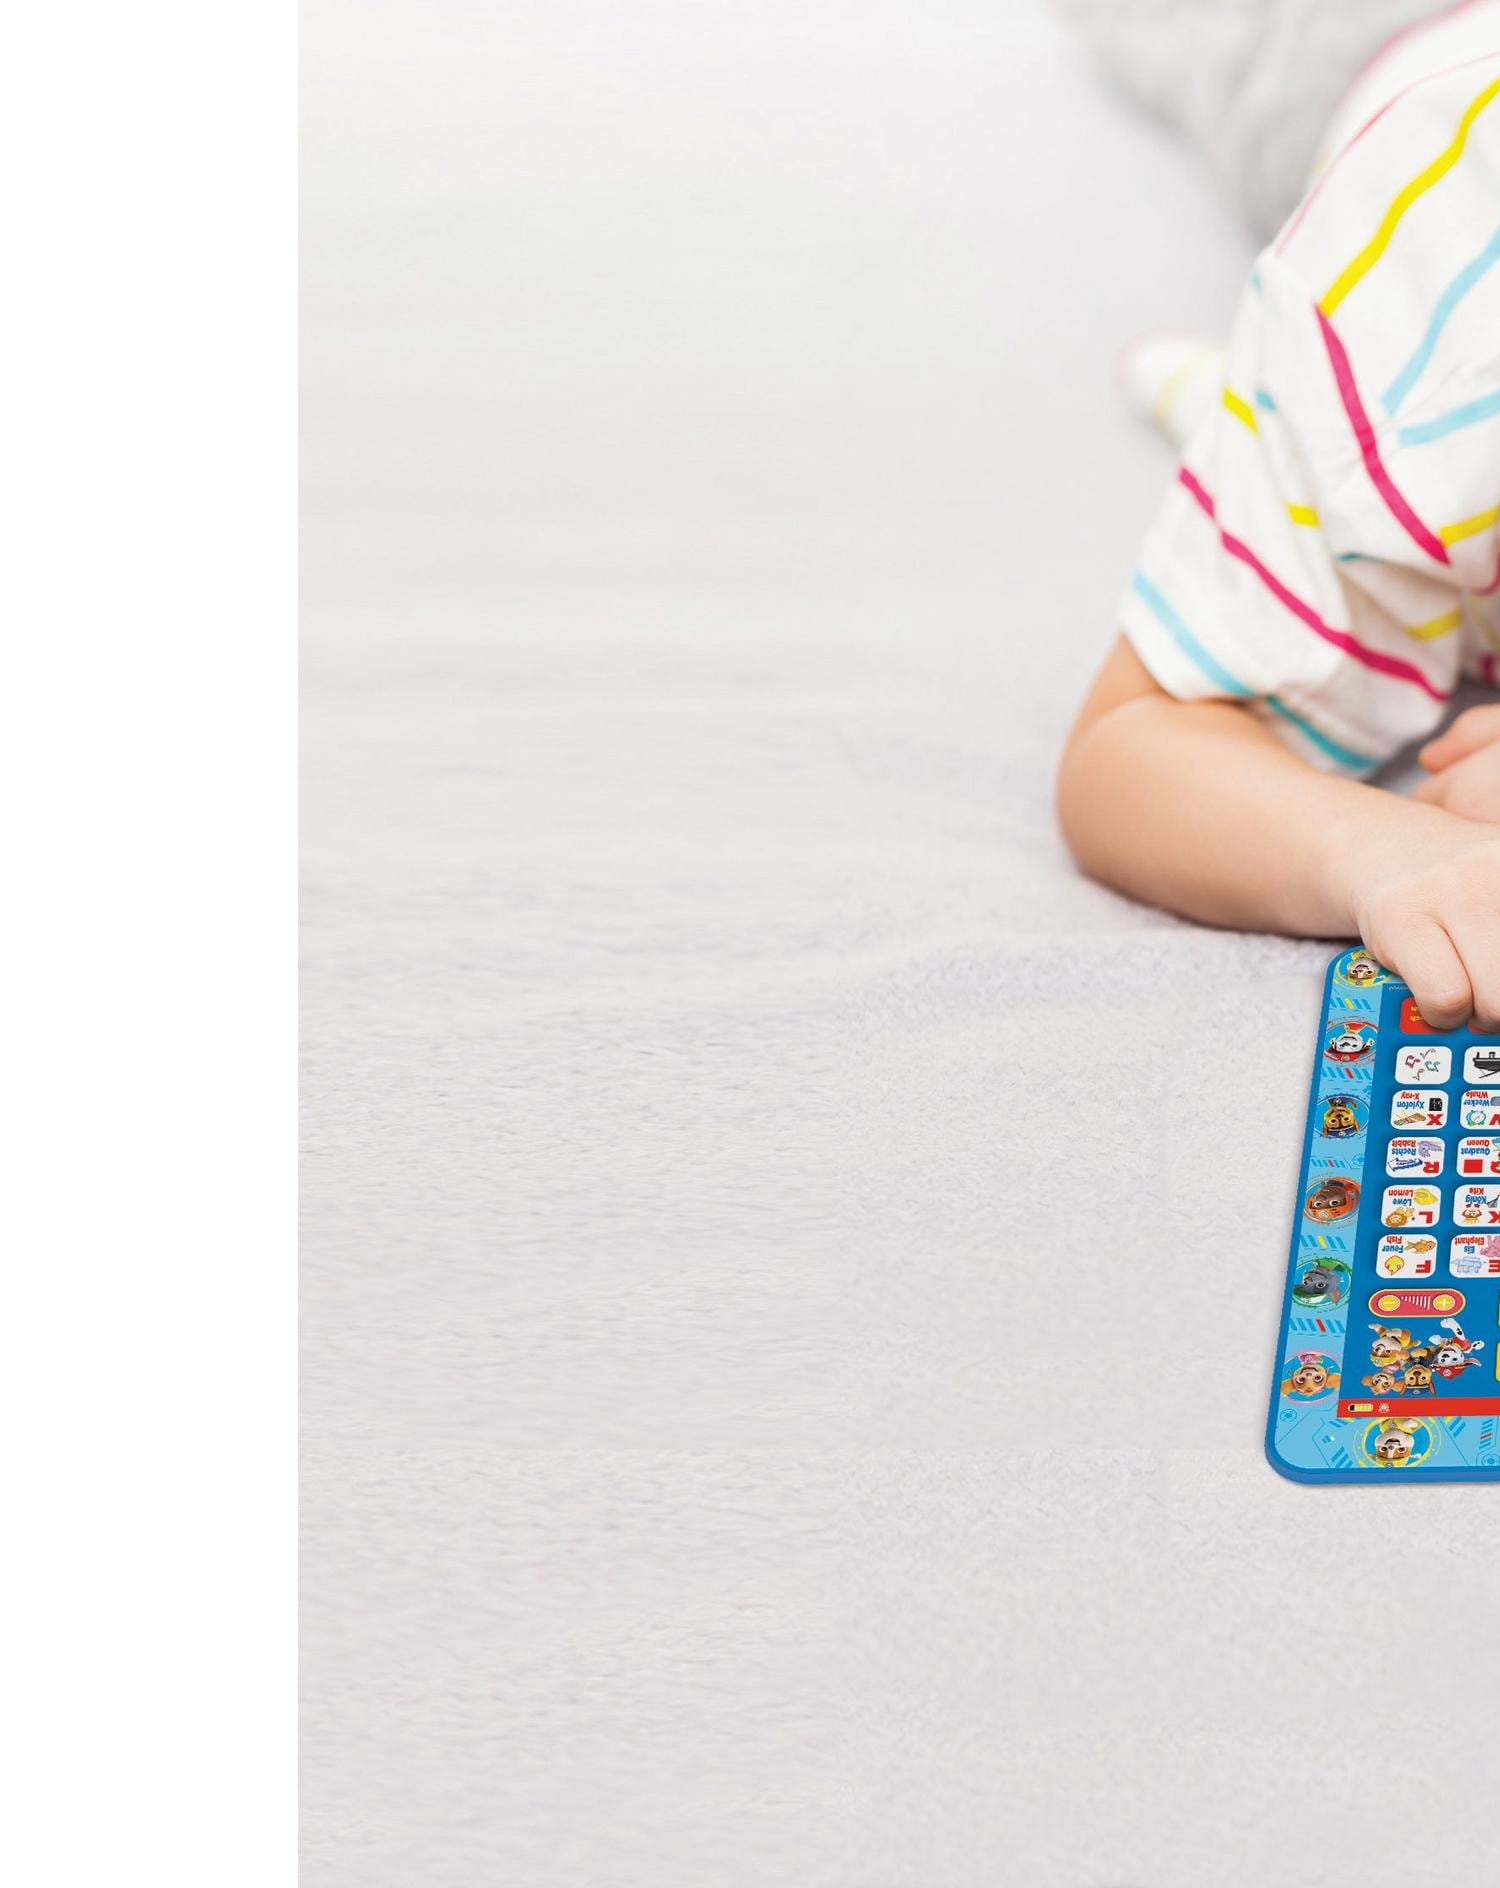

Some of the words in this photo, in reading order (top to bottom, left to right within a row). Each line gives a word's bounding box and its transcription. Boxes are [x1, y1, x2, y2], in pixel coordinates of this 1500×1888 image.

[1401, 1092, 1420, 1100] X-ray
[1397, 1101, 1425, 1109] Xylofon
[1464, 1099, 1490, 1107] Wecker
[1426, 1114, 1443, 1125] X
[1392, 1148, 1416, 1156] Rechts
[1461, 1147, 1490, 1155] Quadrat
[1423, 1162, 1439, 1173] R
[1388, 1190, 1413, 1198] Lemon
[1465, 1195, 1487, 1204] König
[1419, 1212, 1433, 1224] L
[1386, 1236, 1402, 1244] Fish
[1455, 1236, 1484, 1244] Elephant
[1382, 1245, 1404, 1253] Feuer
[1416, 1260, 1431, 1273] F
